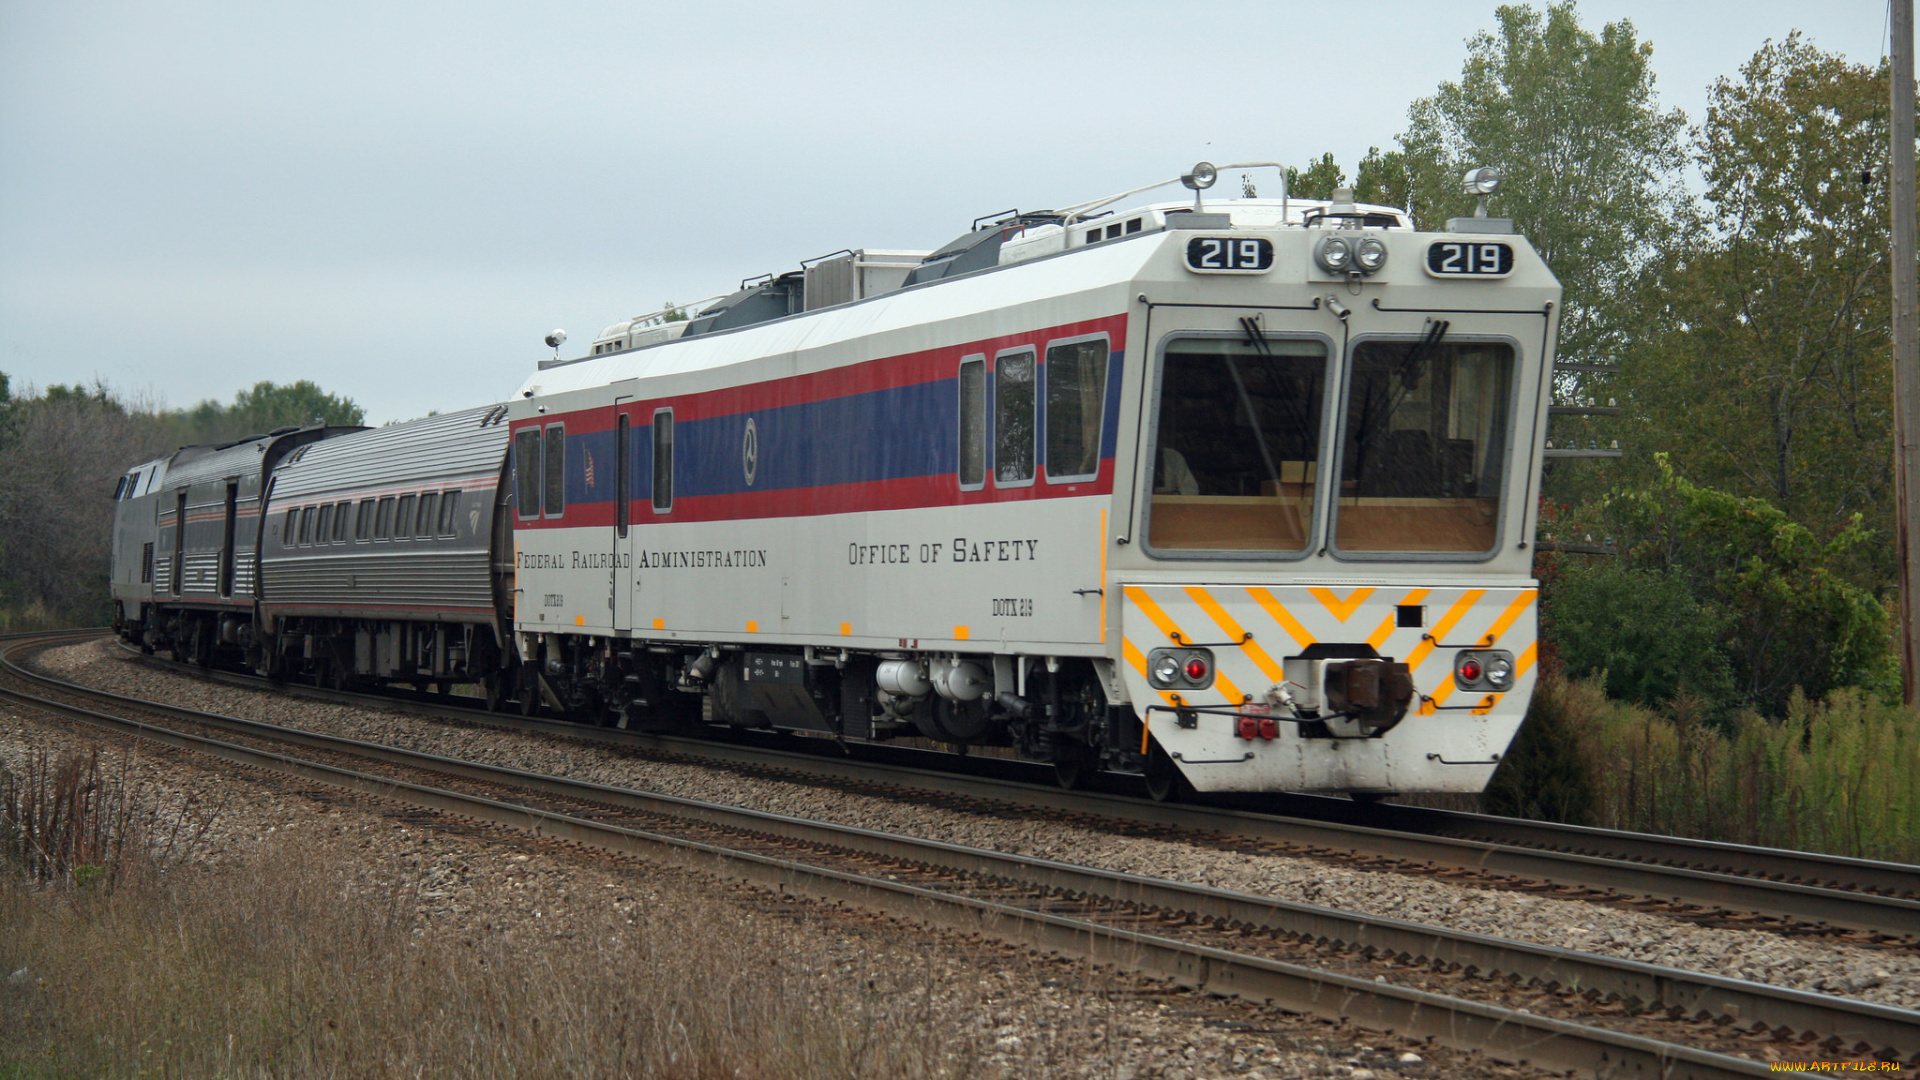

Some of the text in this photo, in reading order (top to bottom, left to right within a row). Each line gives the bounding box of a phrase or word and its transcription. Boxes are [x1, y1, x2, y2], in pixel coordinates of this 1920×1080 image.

[1201, 239, 1260, 268] 219
[1442, 244, 1500, 273] 219
[517, 549, 767, 569] FEDERAL RAILROAD ADMINISTRATION
[849, 538, 1038, 565] OFFICE OF SAFETY
[992, 598, 1033, 617] DOTX 219
